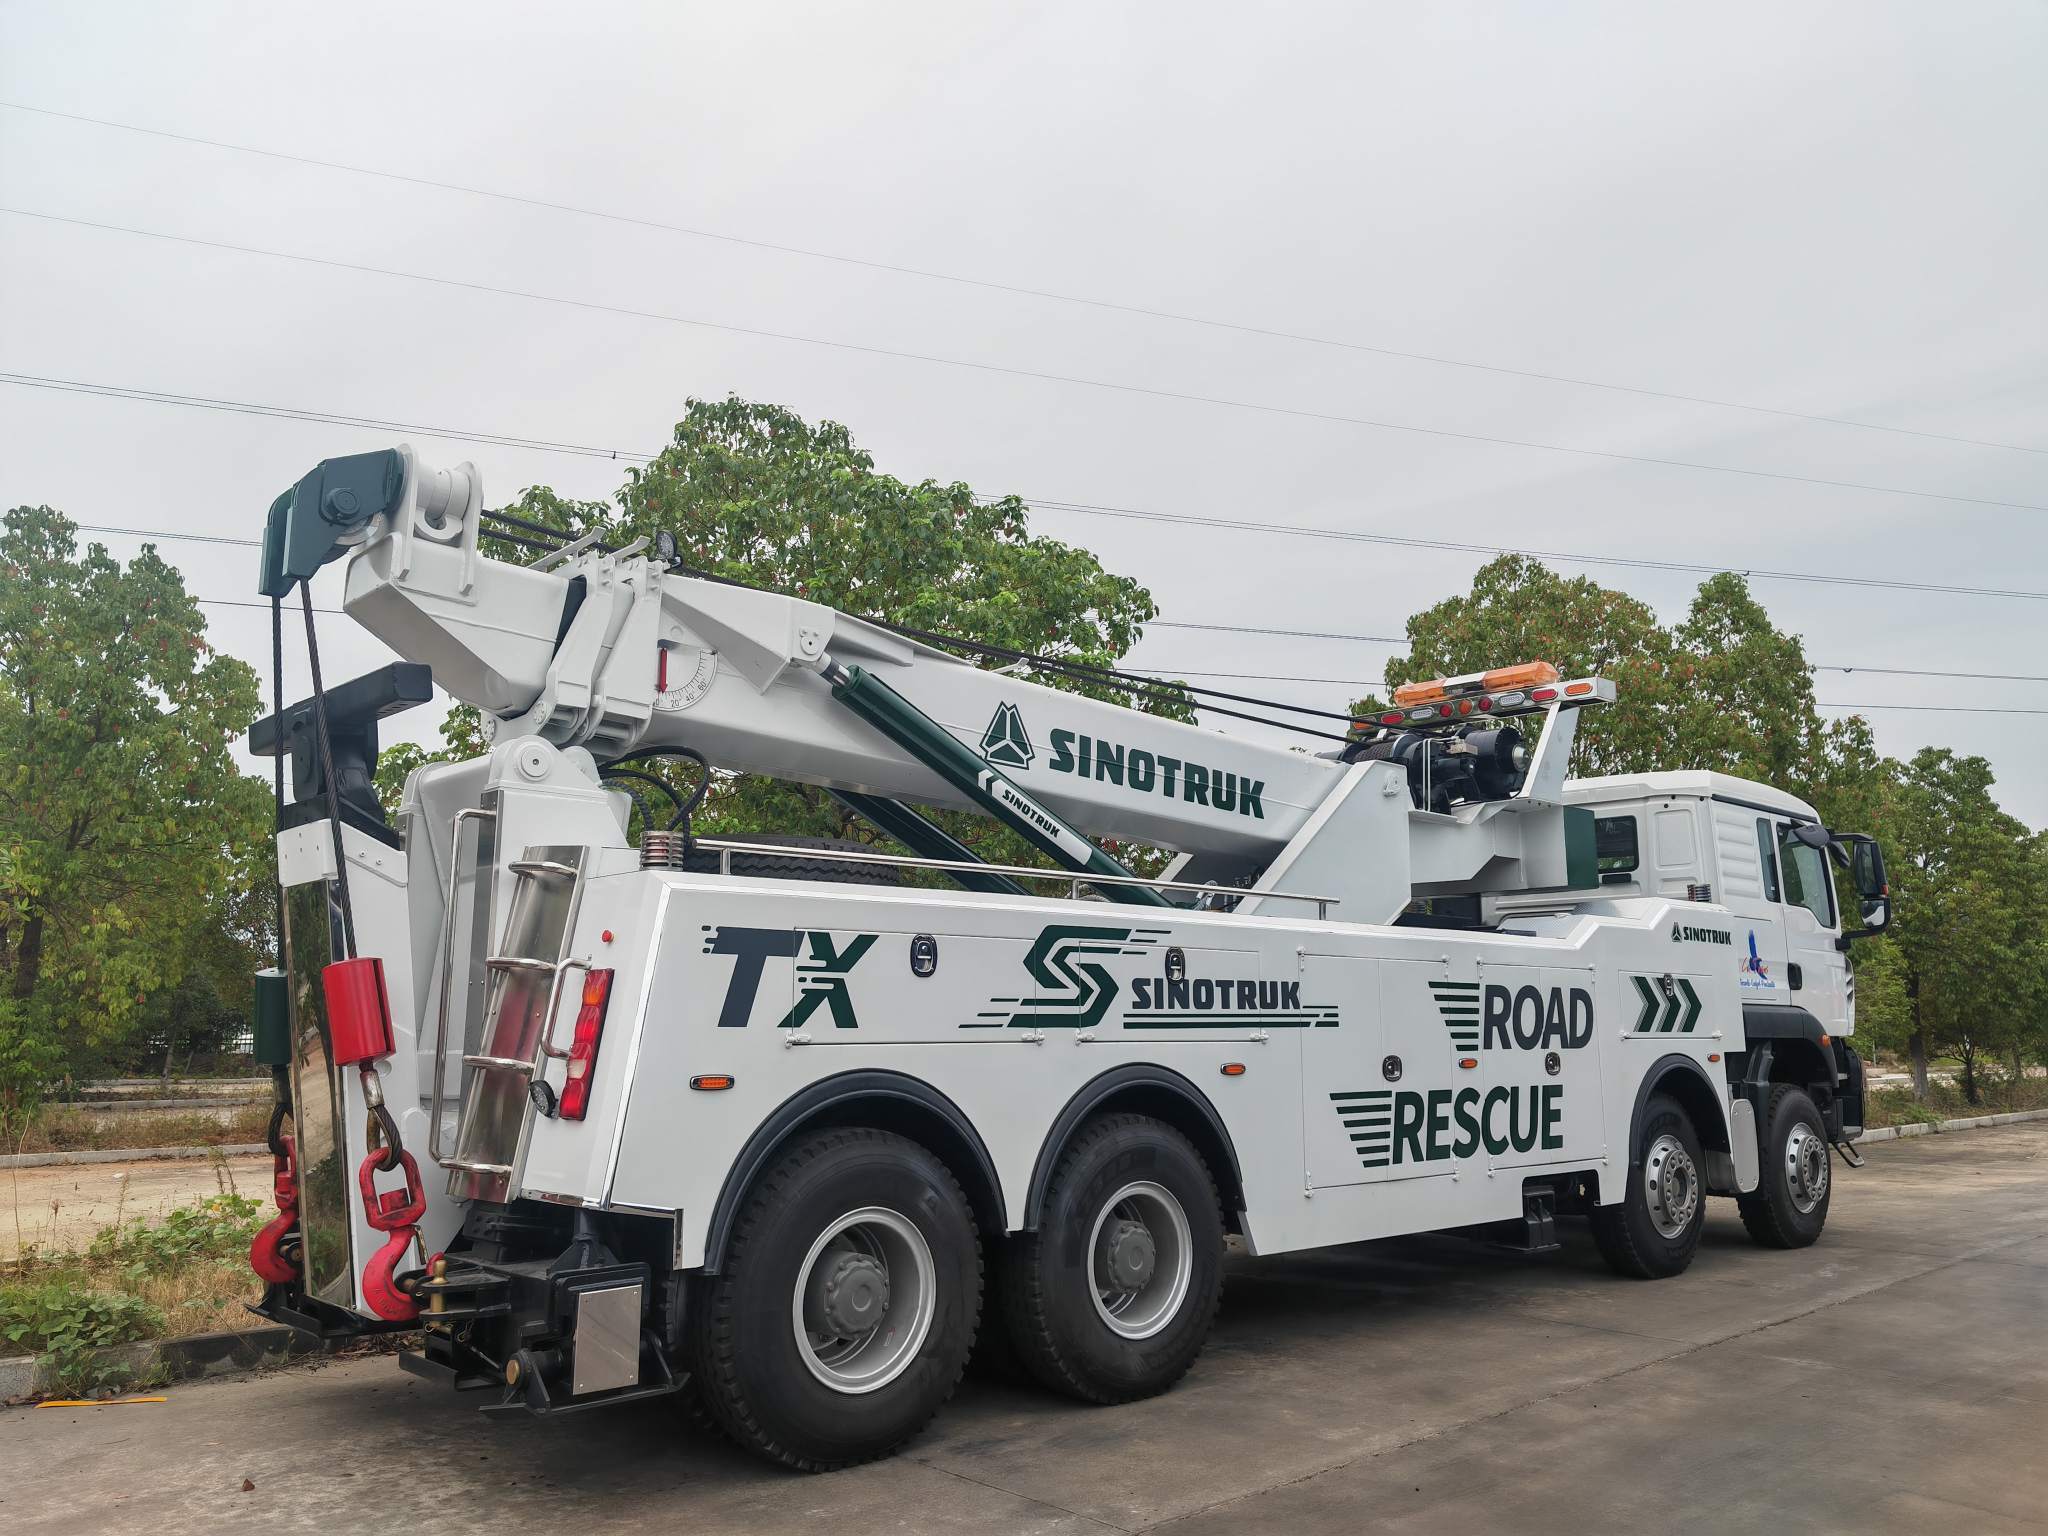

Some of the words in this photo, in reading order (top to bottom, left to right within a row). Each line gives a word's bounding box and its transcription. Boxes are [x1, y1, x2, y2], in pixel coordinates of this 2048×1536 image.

[1049, 728, 1265, 819] SINOTRUK
[1002, 789, 1061, 838] SINOTRUK
[1683, 926, 1732, 945] SINOTRUK
[702, 926, 880, 1028] TX
[1131, 978, 1301, 1011] SINOTRUK
[1483, 984, 1594, 1050] ROAD
[1392, 1084, 1563, 1165] RESCUE
